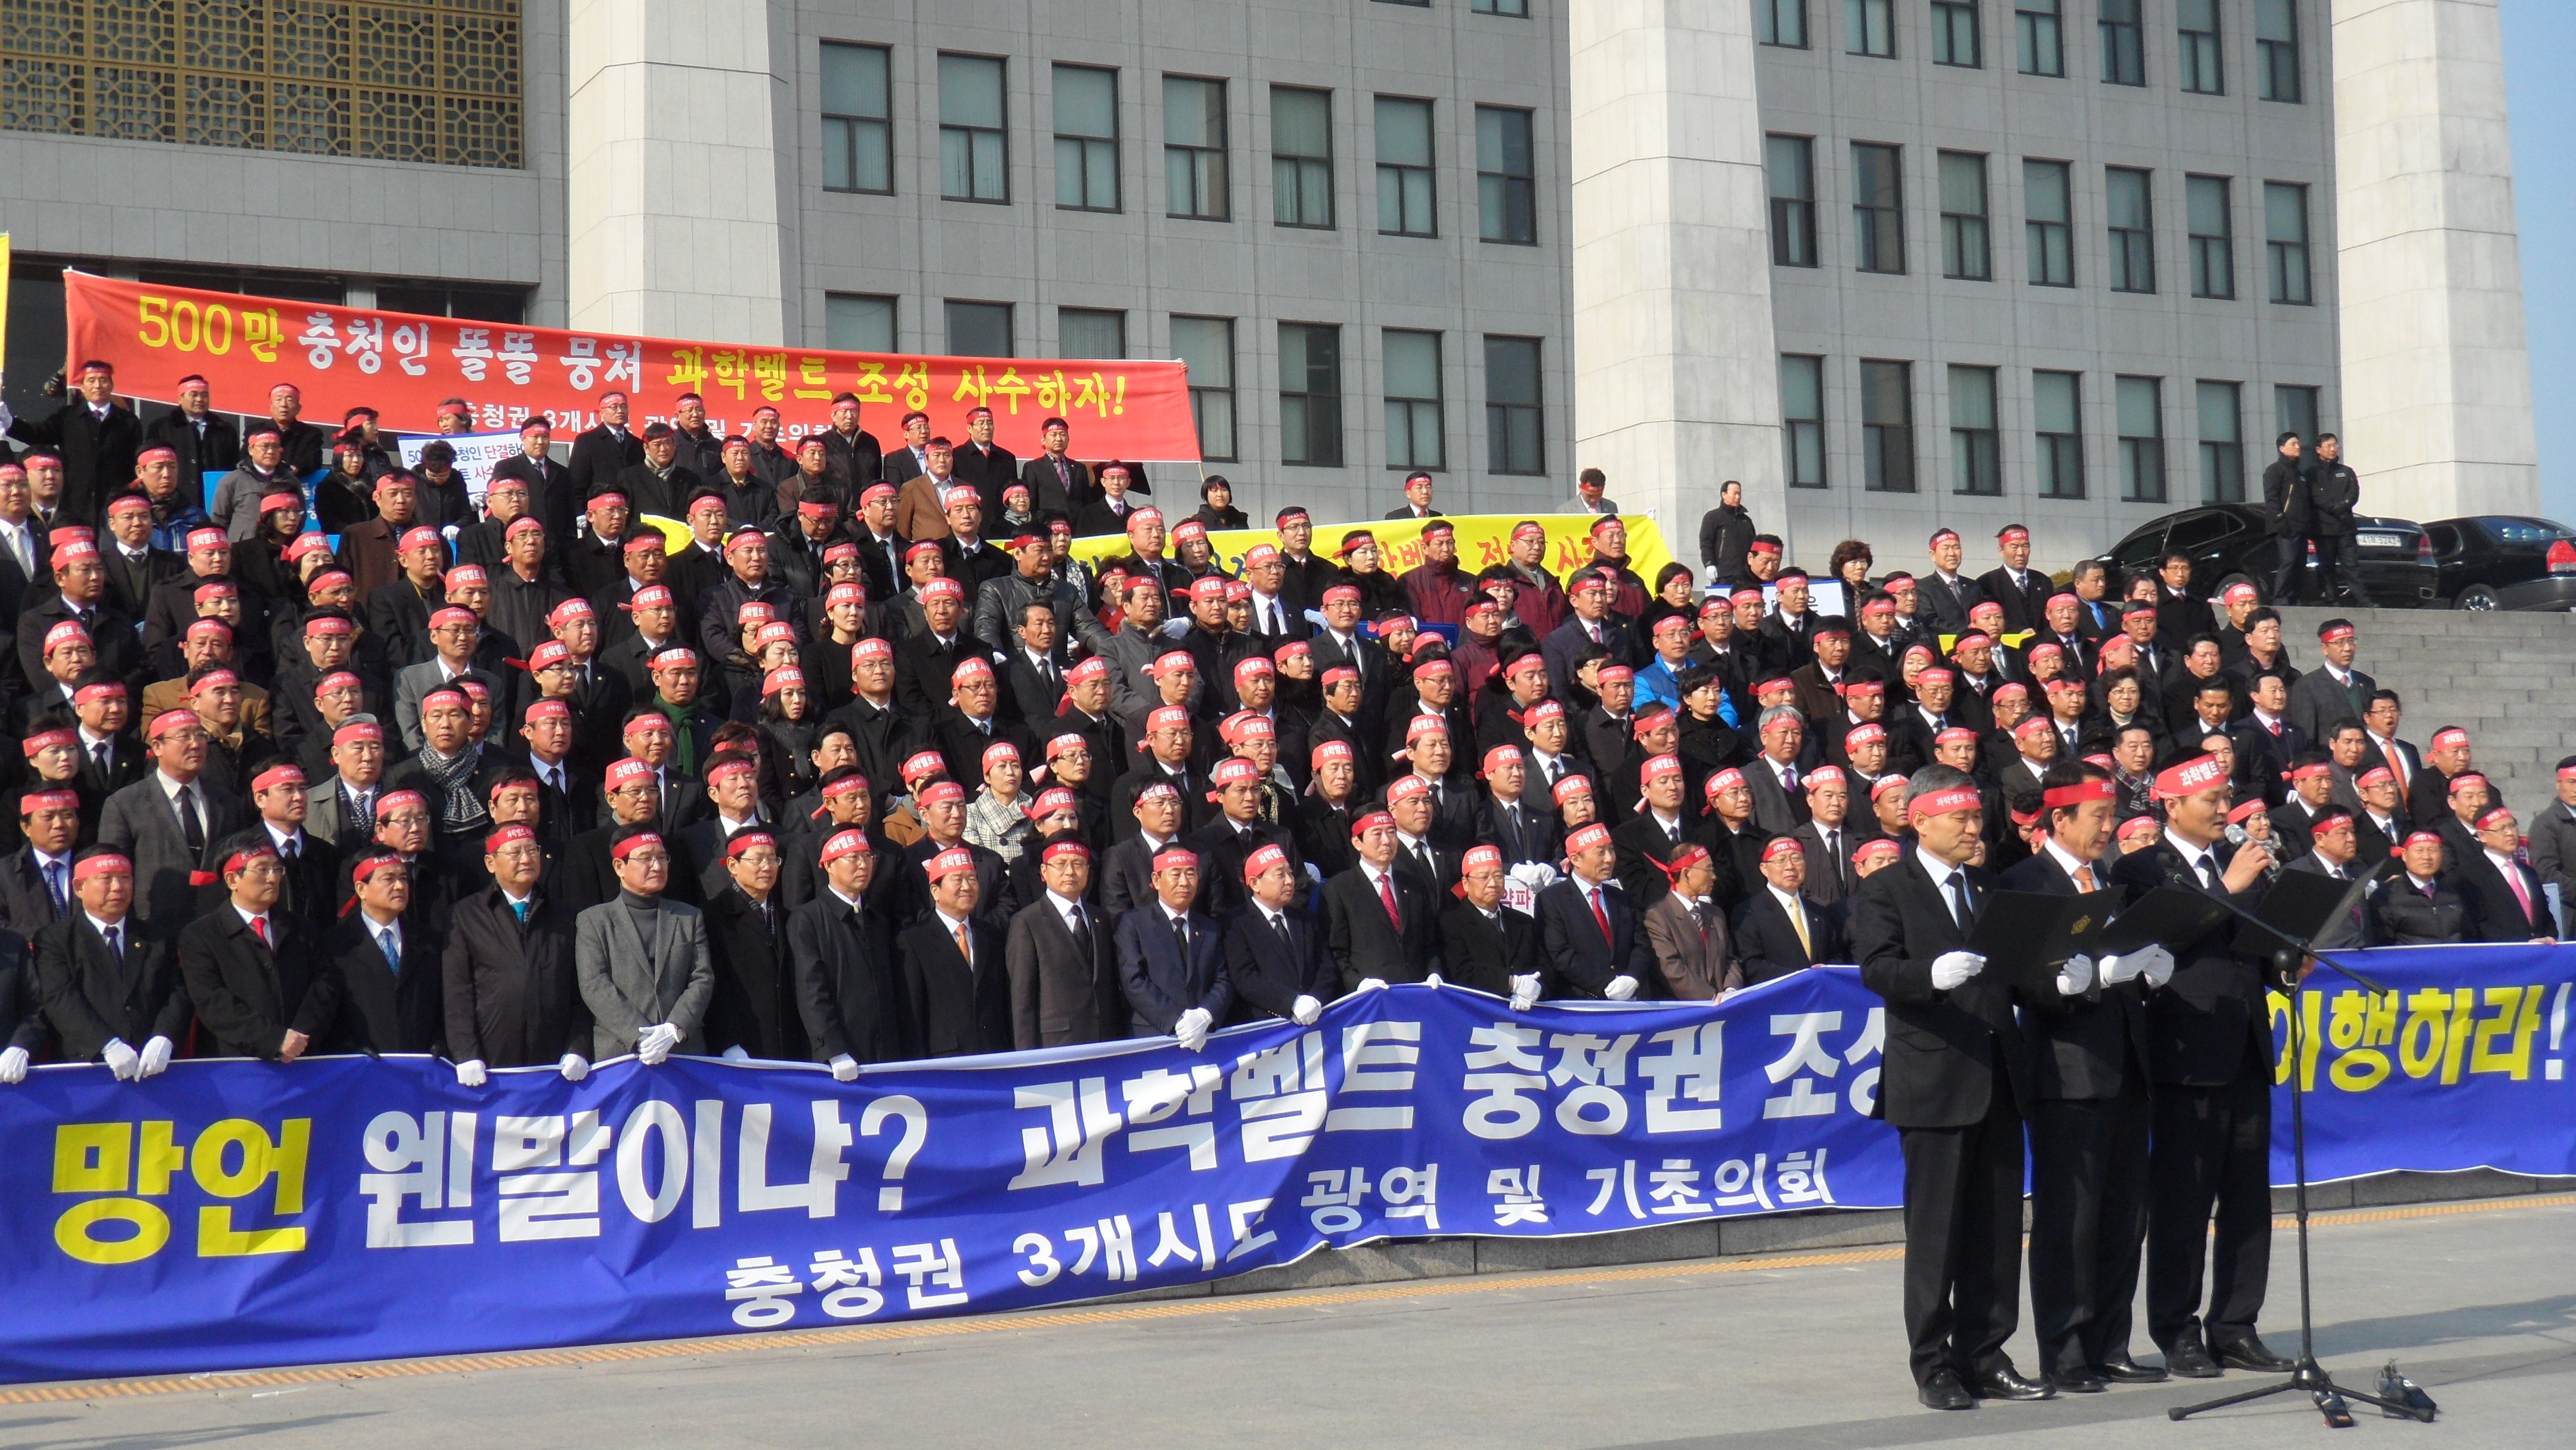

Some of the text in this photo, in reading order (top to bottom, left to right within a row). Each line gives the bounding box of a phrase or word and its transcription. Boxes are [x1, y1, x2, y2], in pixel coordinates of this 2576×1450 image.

[139, 296, 1126, 419] 500만 충청인 똘똘 뭉쳐 과학벨트 조성 사수하자!
[192, 533, 216, 546] 과학벨트
[1252, 547, 1273, 559] 과학벨트
[455, 570, 479, 582] 과학벨트
[926, 581, 946, 594] 과학벨트
[1199, 580, 1221, 592] 과학벨트
[638, 590, 662, 604] 과학벨트
[832, 588, 853, 600] 과학벨트
[562, 603, 587, 616] 과학벨트
[742, 607, 763, 617] 과학벨트
[761, 627, 785, 639] 과학벨트
[541, 645, 564, 658] 과학벨트
[660, 649, 685, 662] 과학벨트
[854, 643, 878, 659] 과학벨트
[1081, 661, 1104, 674] 과학벨트
[1164, 655, 1187, 667] 과학벨트
[956, 662, 978, 678] 과학벨트
[1240, 661, 1262, 676] 과학벨트
[776, 670, 799, 682] 과학벨트
[1159, 710, 1183, 723] 과학벨트
[1536, 704, 1559, 716] 과학벨트
[1243, 722, 1268, 735] 과학벨트
[1410, 719, 1433, 733] 과학벨트
[1055, 733, 1080, 746] 과학벨트
[1850, 729, 1872, 744] 과학벨트
[988, 746, 1013, 760] 과학벨트
[1323, 745, 1346, 757] 과학벨트
[615, 762, 643, 777] 과학벨트
[909, 756, 935, 773] 과학벨트
[1650, 758, 1674, 772] 과학벨트
[1221, 765, 1246, 778] 과학벨트
[1813, 770, 1835, 782] 과학벨트
[2181, 761, 2221, 786] 과학벨트
[1395, 782, 1420, 795] 과학벨트
[1558, 779, 1581, 797] 과학벨트
[1711, 773, 1733, 791] 과학벨트
[1045, 792, 1070, 805] 과학벨트
[1936, 794, 1965, 806] 과학벨트
[1577, 829, 1602, 846] 과학벨트
[828, 835, 856, 854] 과학벨트
[940, 854, 967, 868] 과학벨트
[1468, 850, 1493, 865] 과학벨트
[2266, 982, 2572, 1092] 이행하라!
[52, 1117, 311, 1264] 망언
[360, 1095, 928, 1248] 웬말이냐?
[1007, 1021, 1422, 1192] 과학벨트
[1463, 1020, 1726, 1140] 충청권
[726, 1148, 1836, 1328] 충청권 3개시도 광역 및 기초의회
